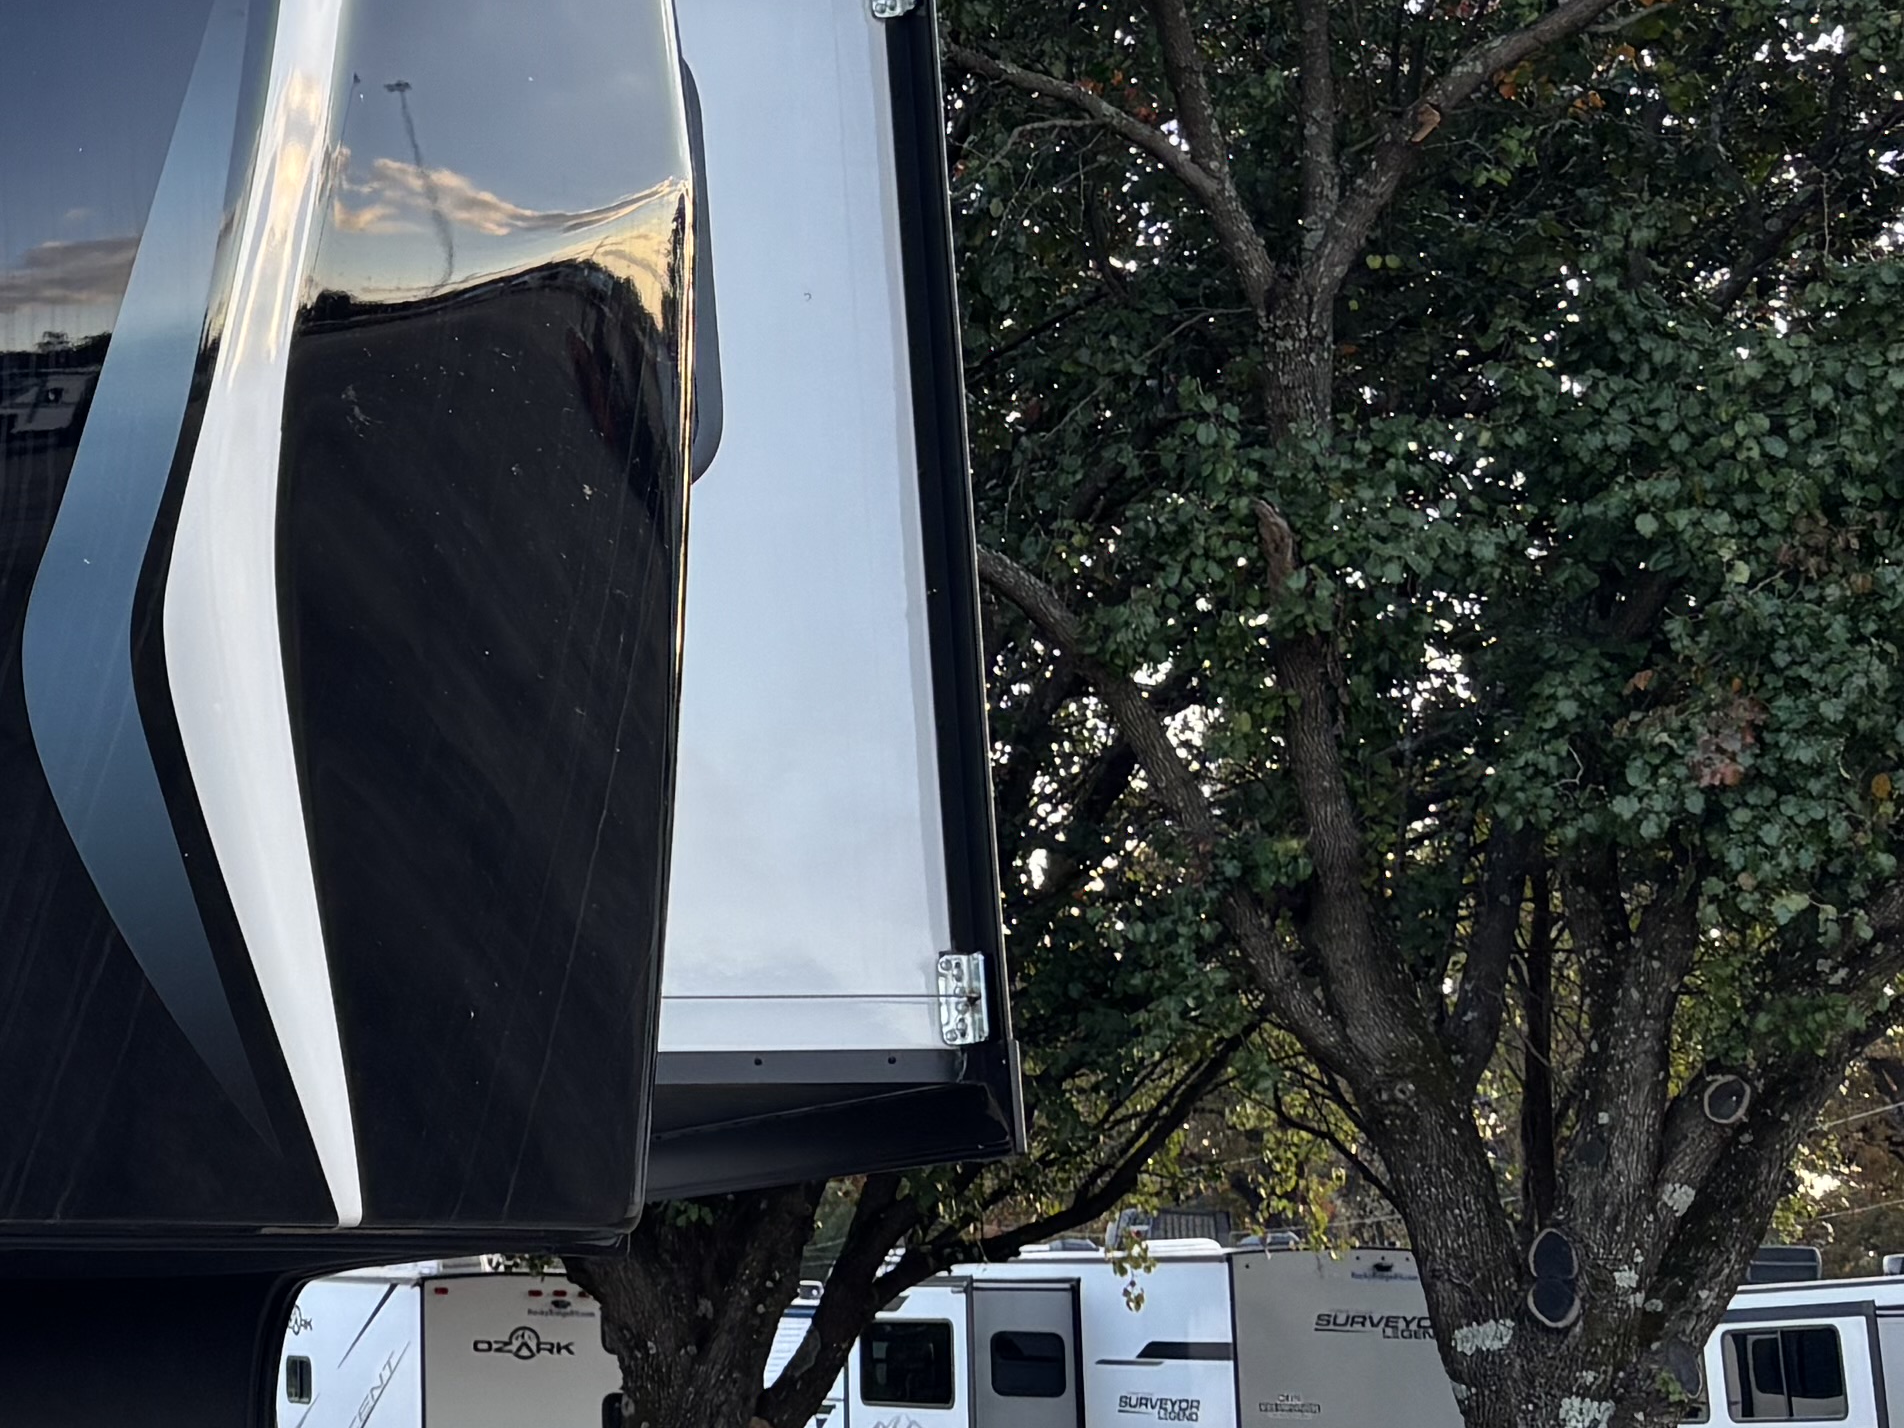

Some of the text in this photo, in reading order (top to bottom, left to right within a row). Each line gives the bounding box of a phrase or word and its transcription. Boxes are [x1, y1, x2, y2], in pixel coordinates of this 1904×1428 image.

[1315, 1313, 1433, 1329] SURVEYO
[1383, 1328, 1437, 1340] LEGEN
[473, 1327, 575, 1360] OZARK
[1118, 1395, 1201, 1412] SURVEYOR
[1157, 1410, 1199, 1422] LEGEND
